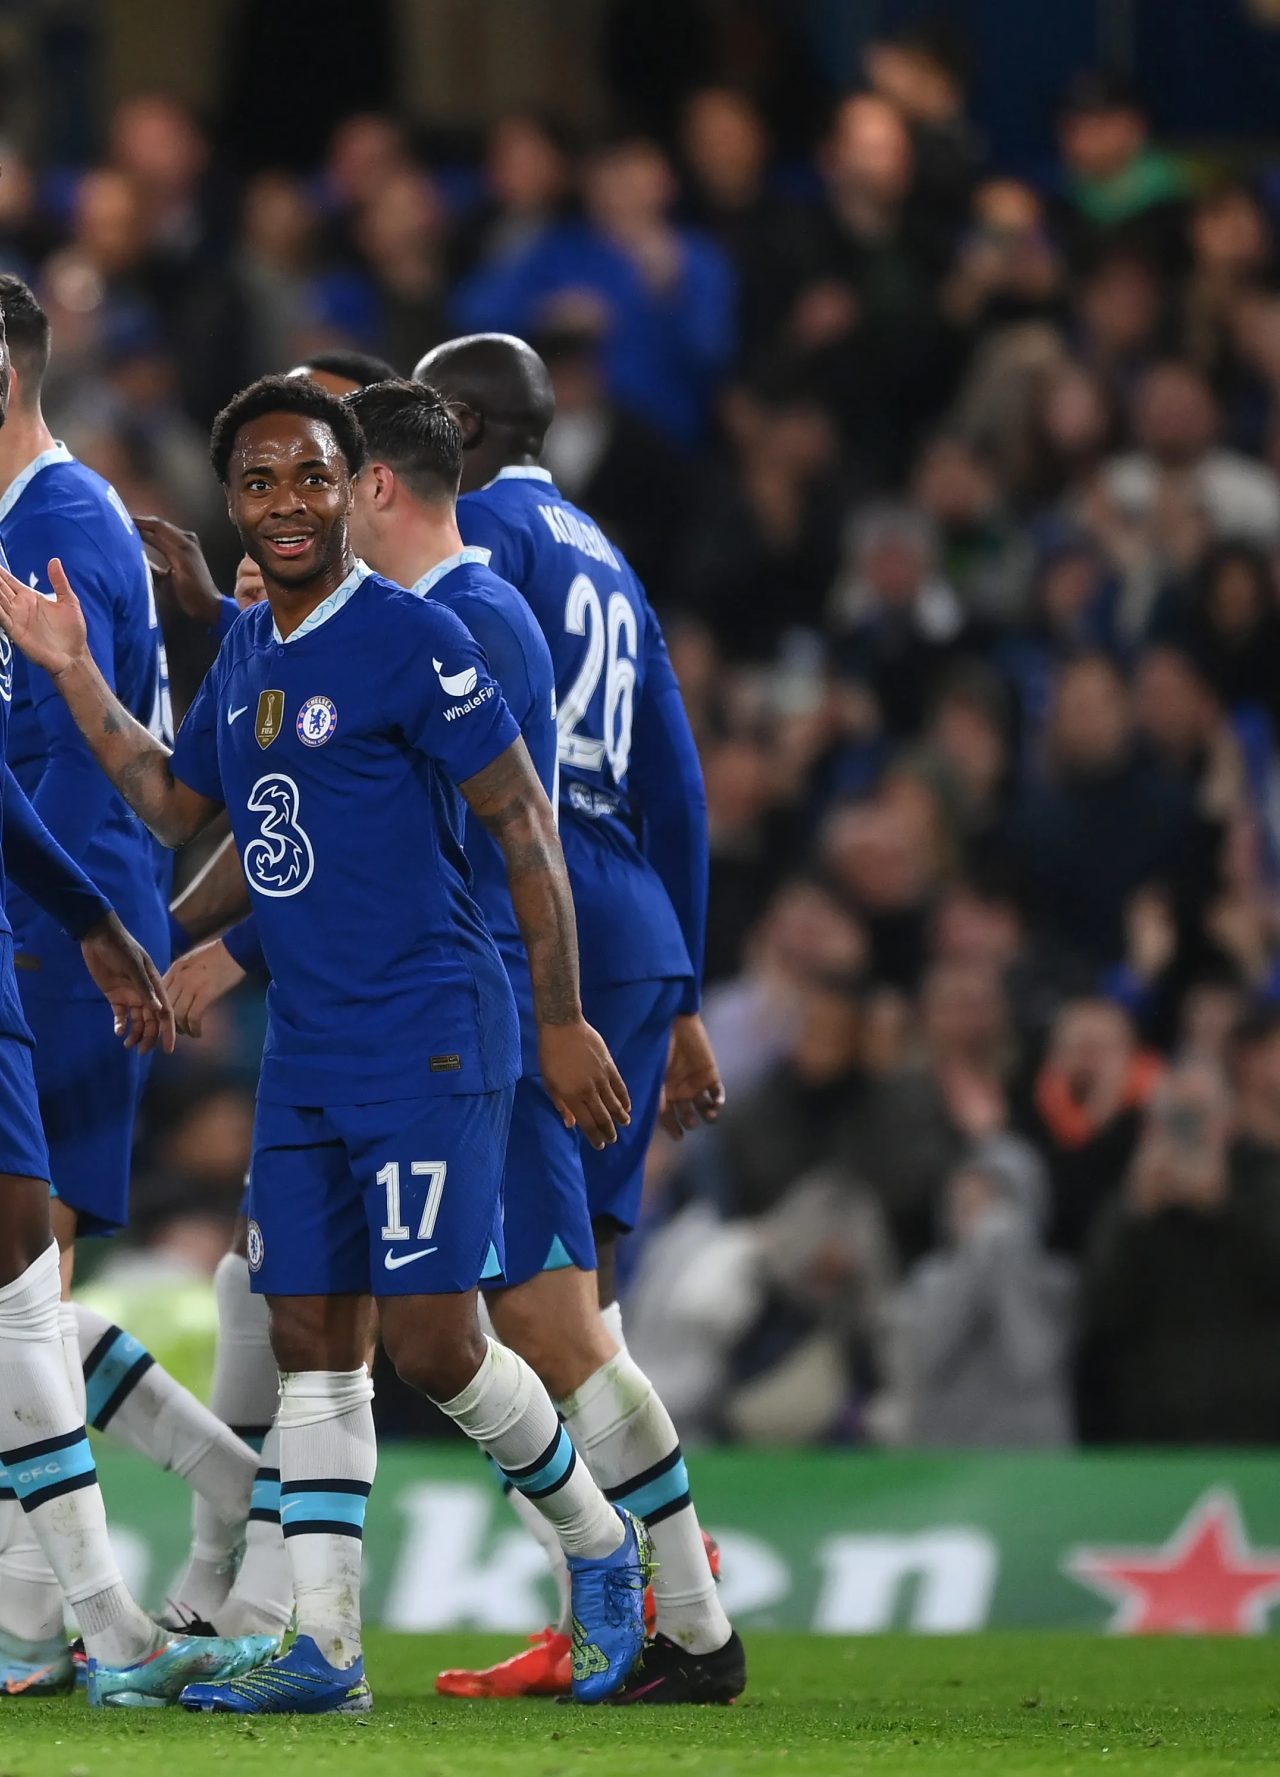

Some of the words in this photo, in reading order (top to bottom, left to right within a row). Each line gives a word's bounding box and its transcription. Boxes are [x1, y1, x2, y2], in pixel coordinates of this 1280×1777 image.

[442, 686, 495, 721] WhaleFin
[557, 573, 637, 784] 26
[376, 1160, 447, 1241] 17
[18, 1461, 62, 1484] CFC
